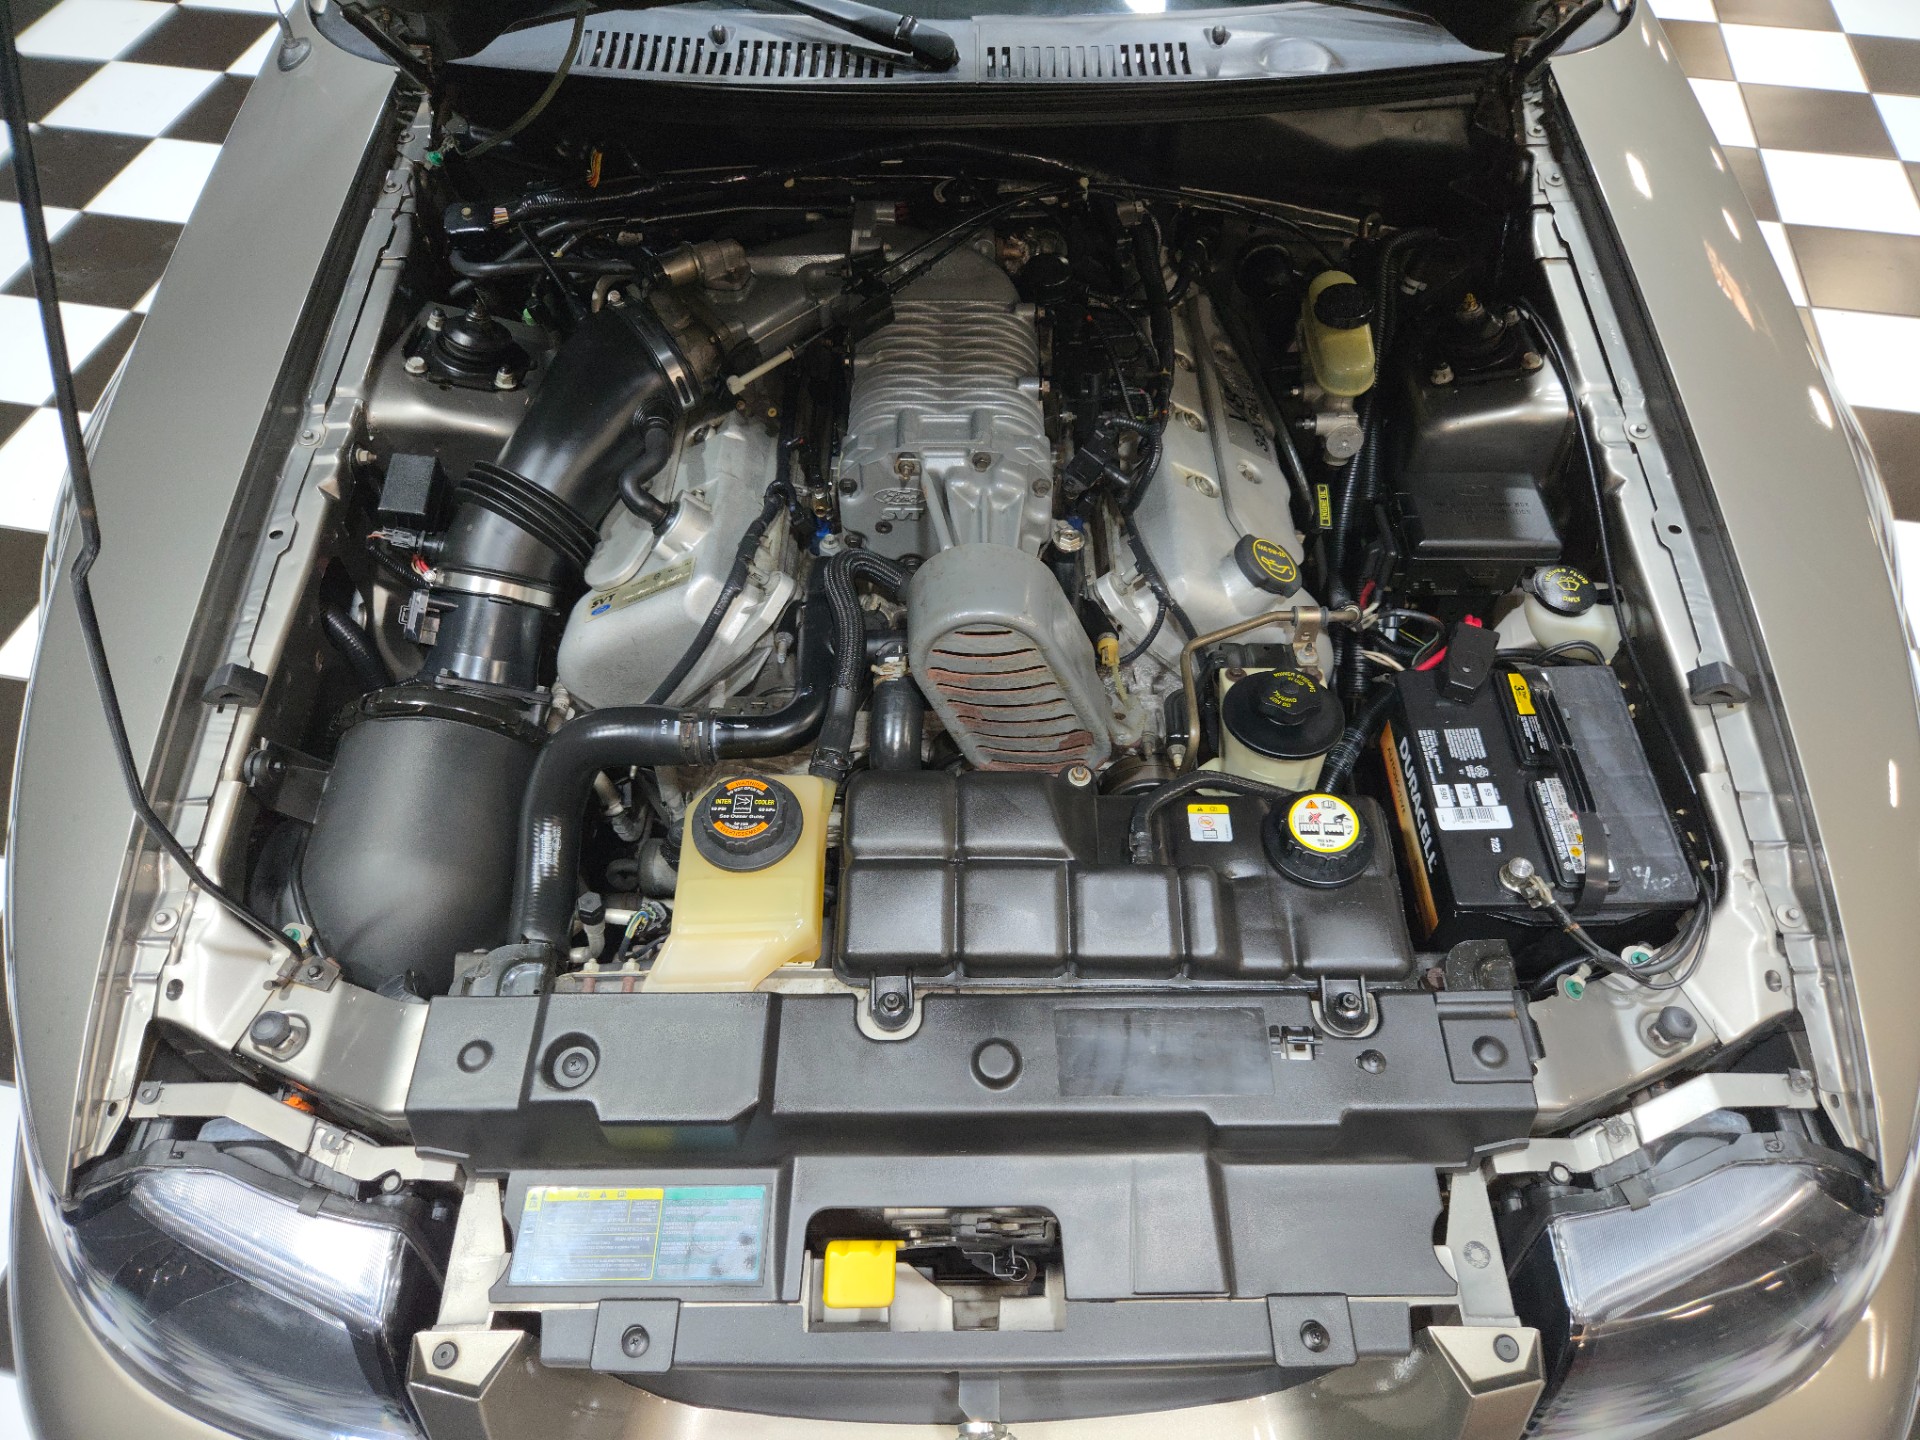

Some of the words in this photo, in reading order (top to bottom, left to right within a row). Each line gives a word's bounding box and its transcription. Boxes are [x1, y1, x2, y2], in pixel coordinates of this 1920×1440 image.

[881, 507, 924, 521] SVT
[1321, 500, 1329, 520] ENGINE
[1569, 569, 1589, 585] FLUID
[590, 593, 617, 609] SVT
[1562, 595, 1581, 603] ONLY
[1439, 787, 1449, 800] 590
[1461, 786, 1471, 800] 725
[1399, 736, 1434, 873] DURACELL
[1490, 837, 1501, 853] 7/23
